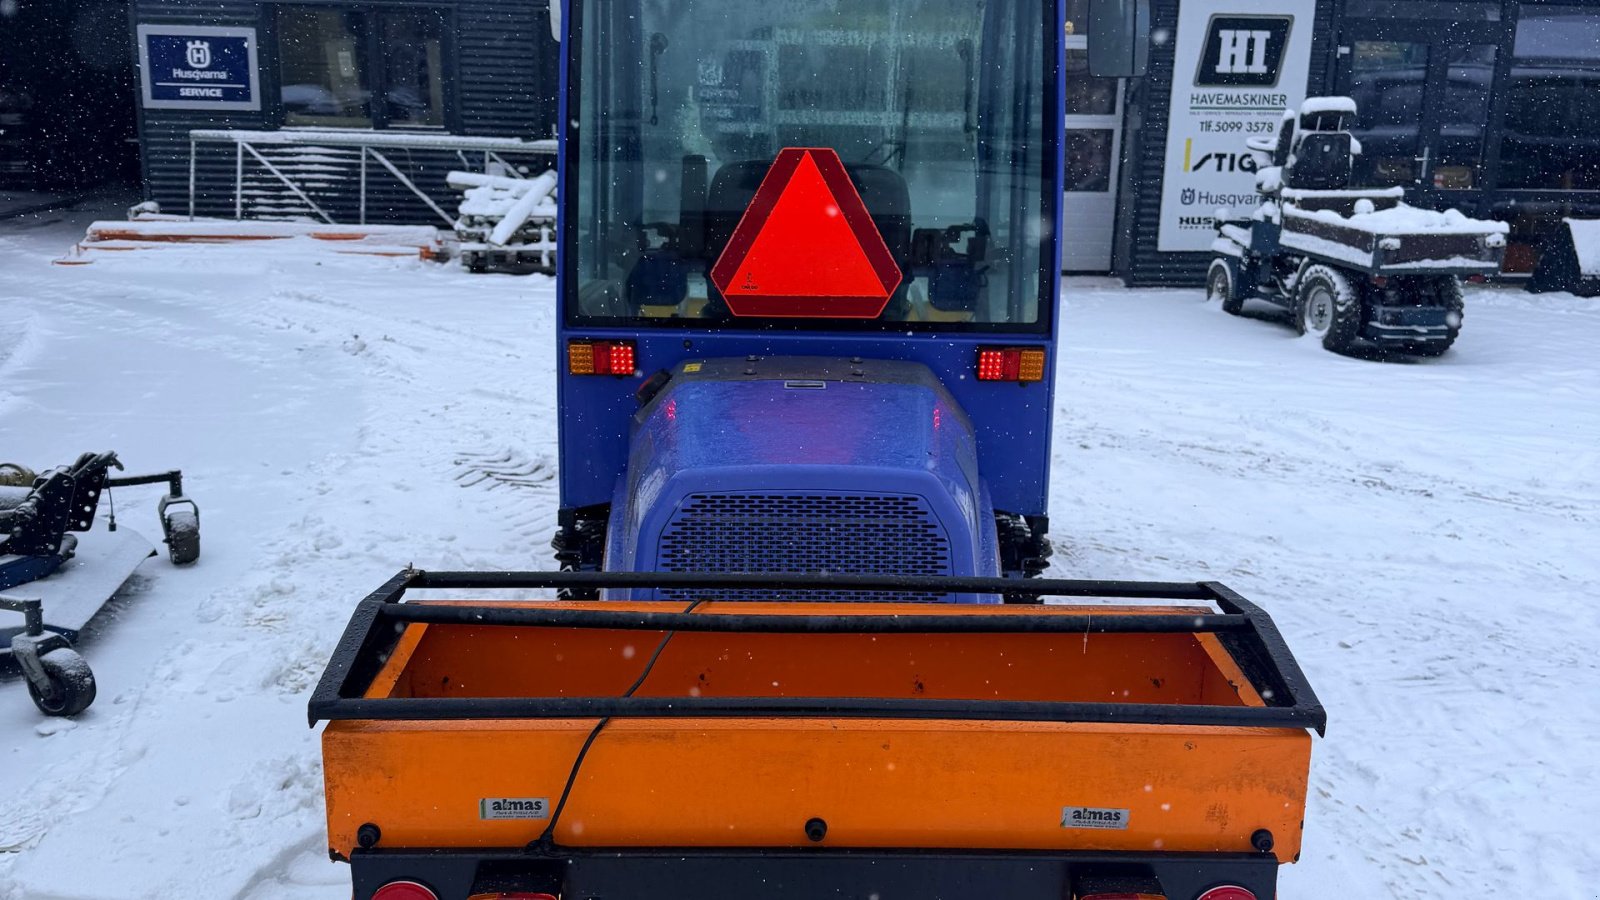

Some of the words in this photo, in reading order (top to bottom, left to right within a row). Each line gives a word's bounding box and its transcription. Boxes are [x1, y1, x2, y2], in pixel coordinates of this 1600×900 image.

[1215, 29, 1271, 73] HI
[172, 68, 228, 80] Husqvarna
[179, 87, 223, 97] SERVICE
[1189, 93, 1287, 106] HAVEMASKINER
[1245, 121, 1274, 133] 3578
[1191, 152, 1257, 173] STIG
[1198, 191, 1263, 208] Husqvar
[492, 798, 542, 811] almas
[1072, 807, 1121, 820] almas
